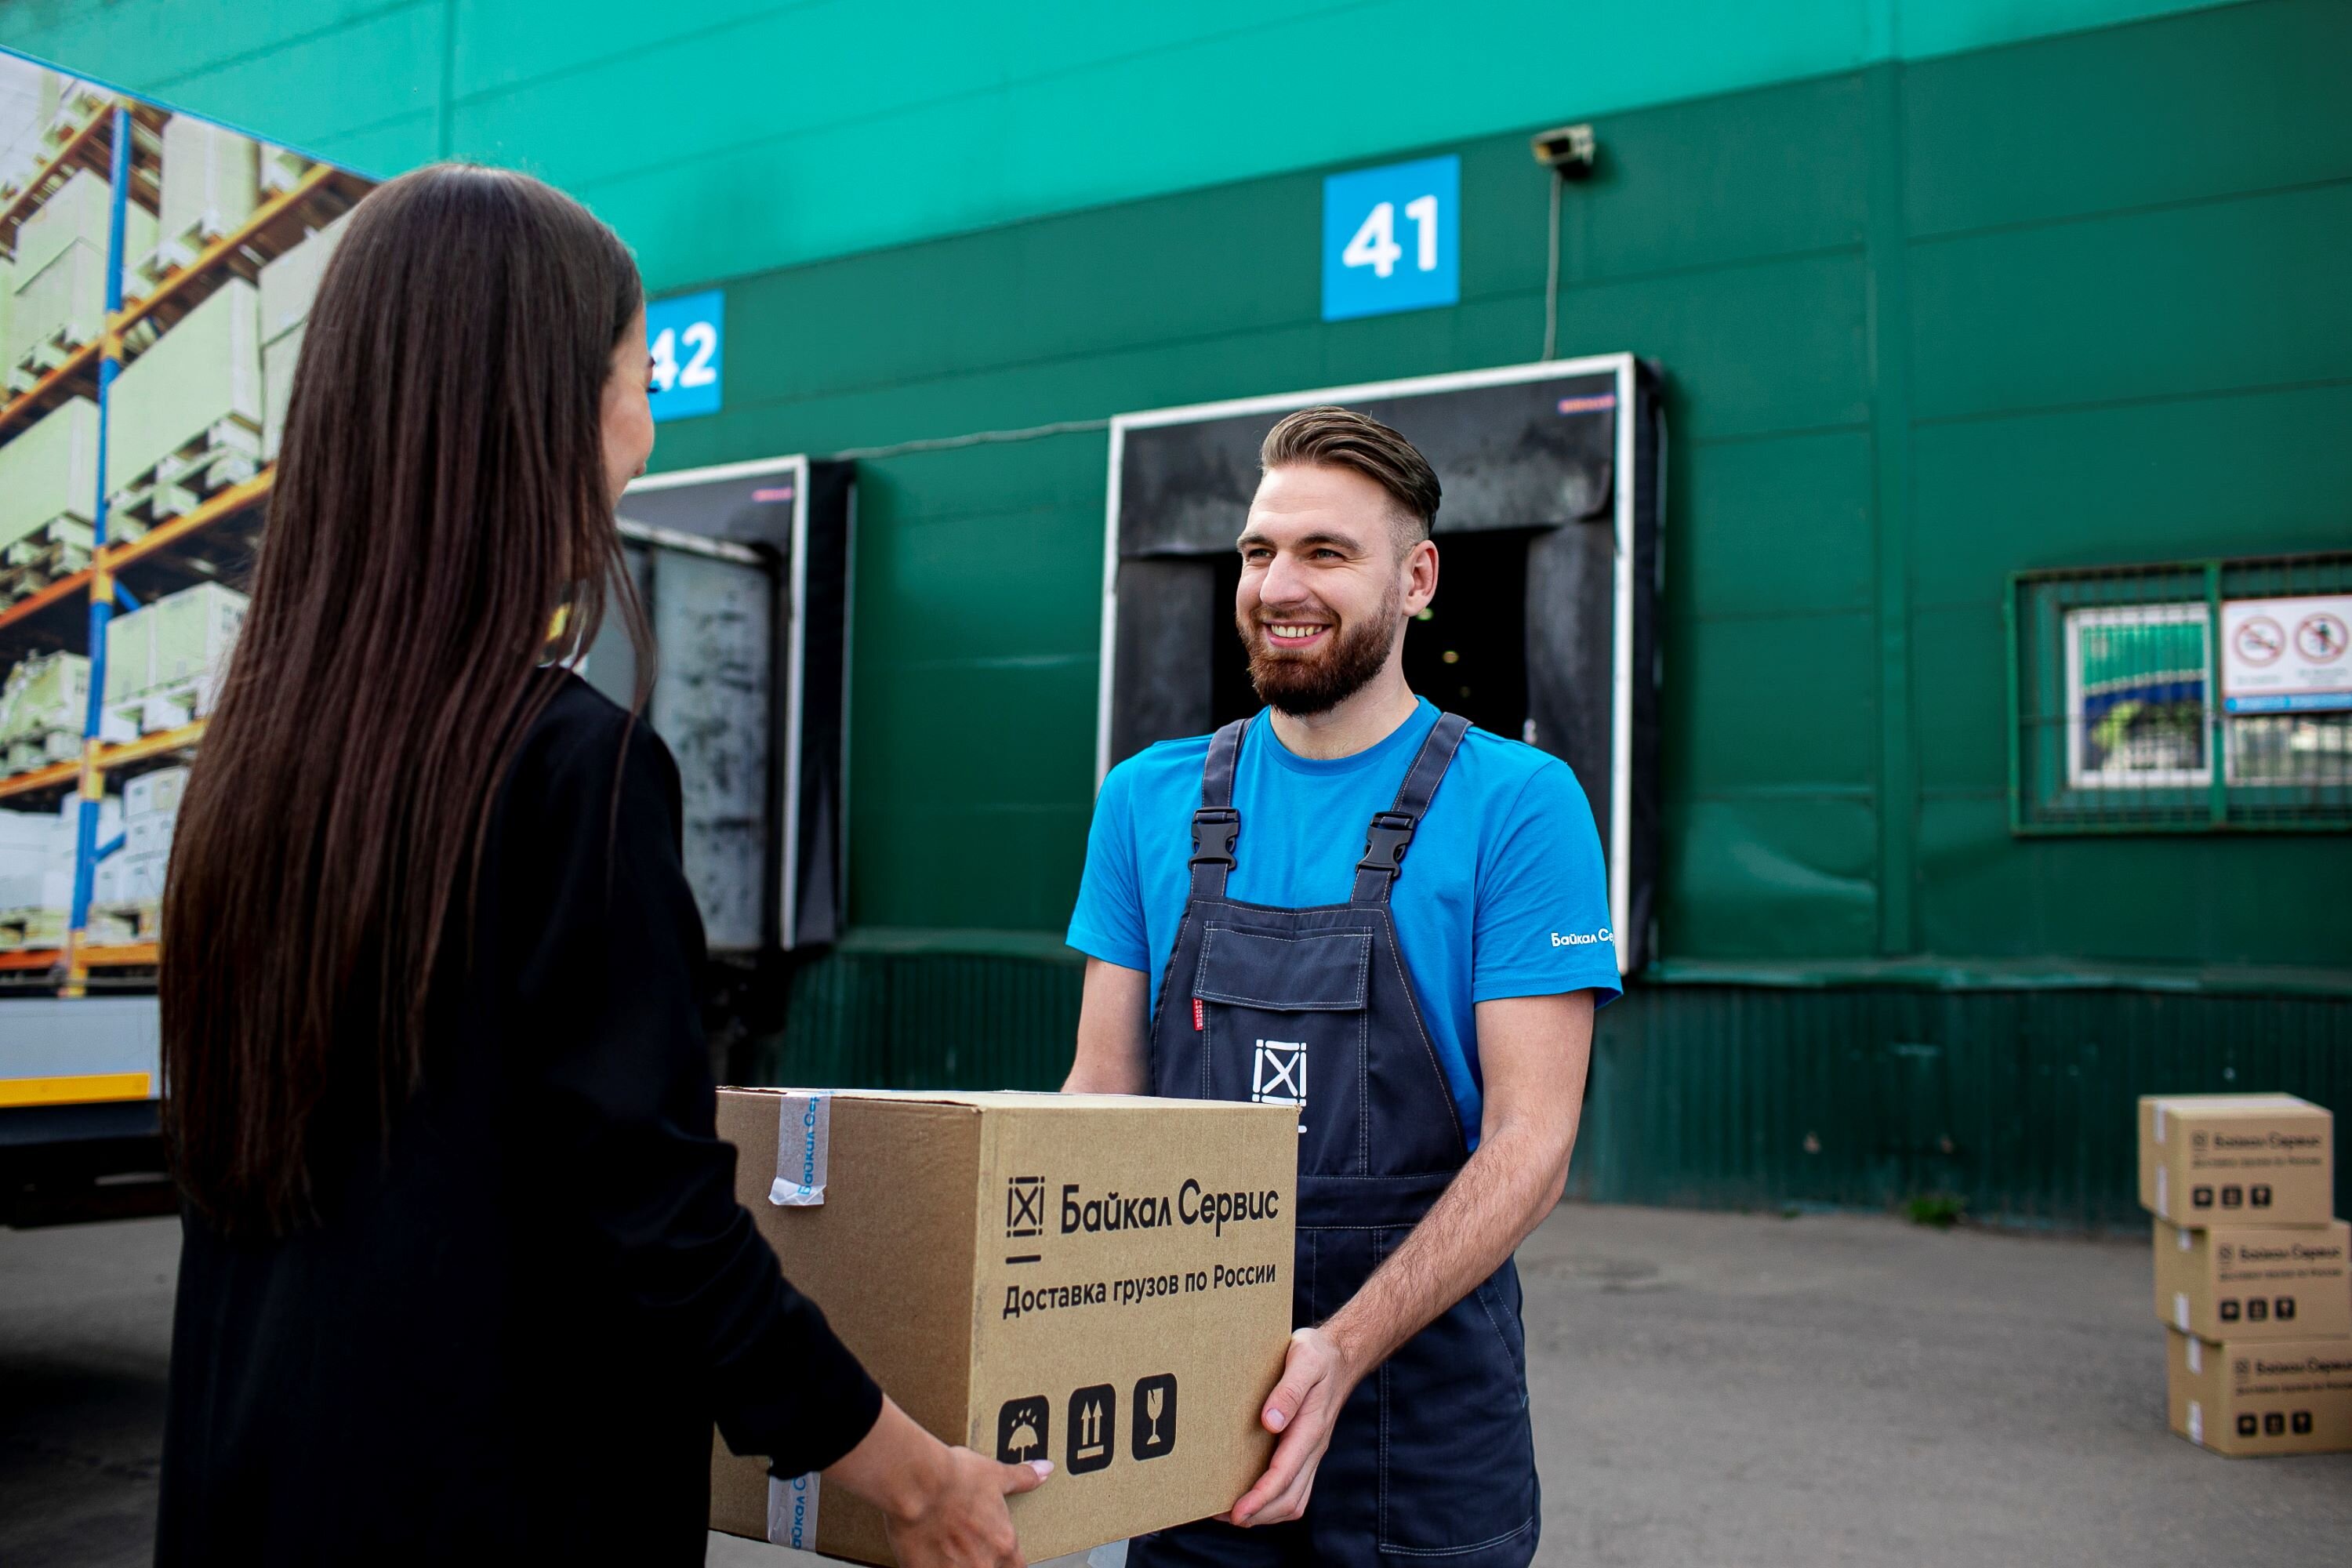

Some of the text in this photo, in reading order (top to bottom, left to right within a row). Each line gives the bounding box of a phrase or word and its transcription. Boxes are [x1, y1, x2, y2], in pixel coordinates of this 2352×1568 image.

[1341, 194, 1438, 278] 41
[651, 321, 717, 392] 42
[1551, 932, 1597, 946] Байкал
[798, 1131, 815, 1195] Байкал
[1061, 1178, 1279, 1237] Байкал Сервис
[1003, 1264, 1276, 1319] Доставка грузов по России
[791, 1496, 805, 1548] айкал
